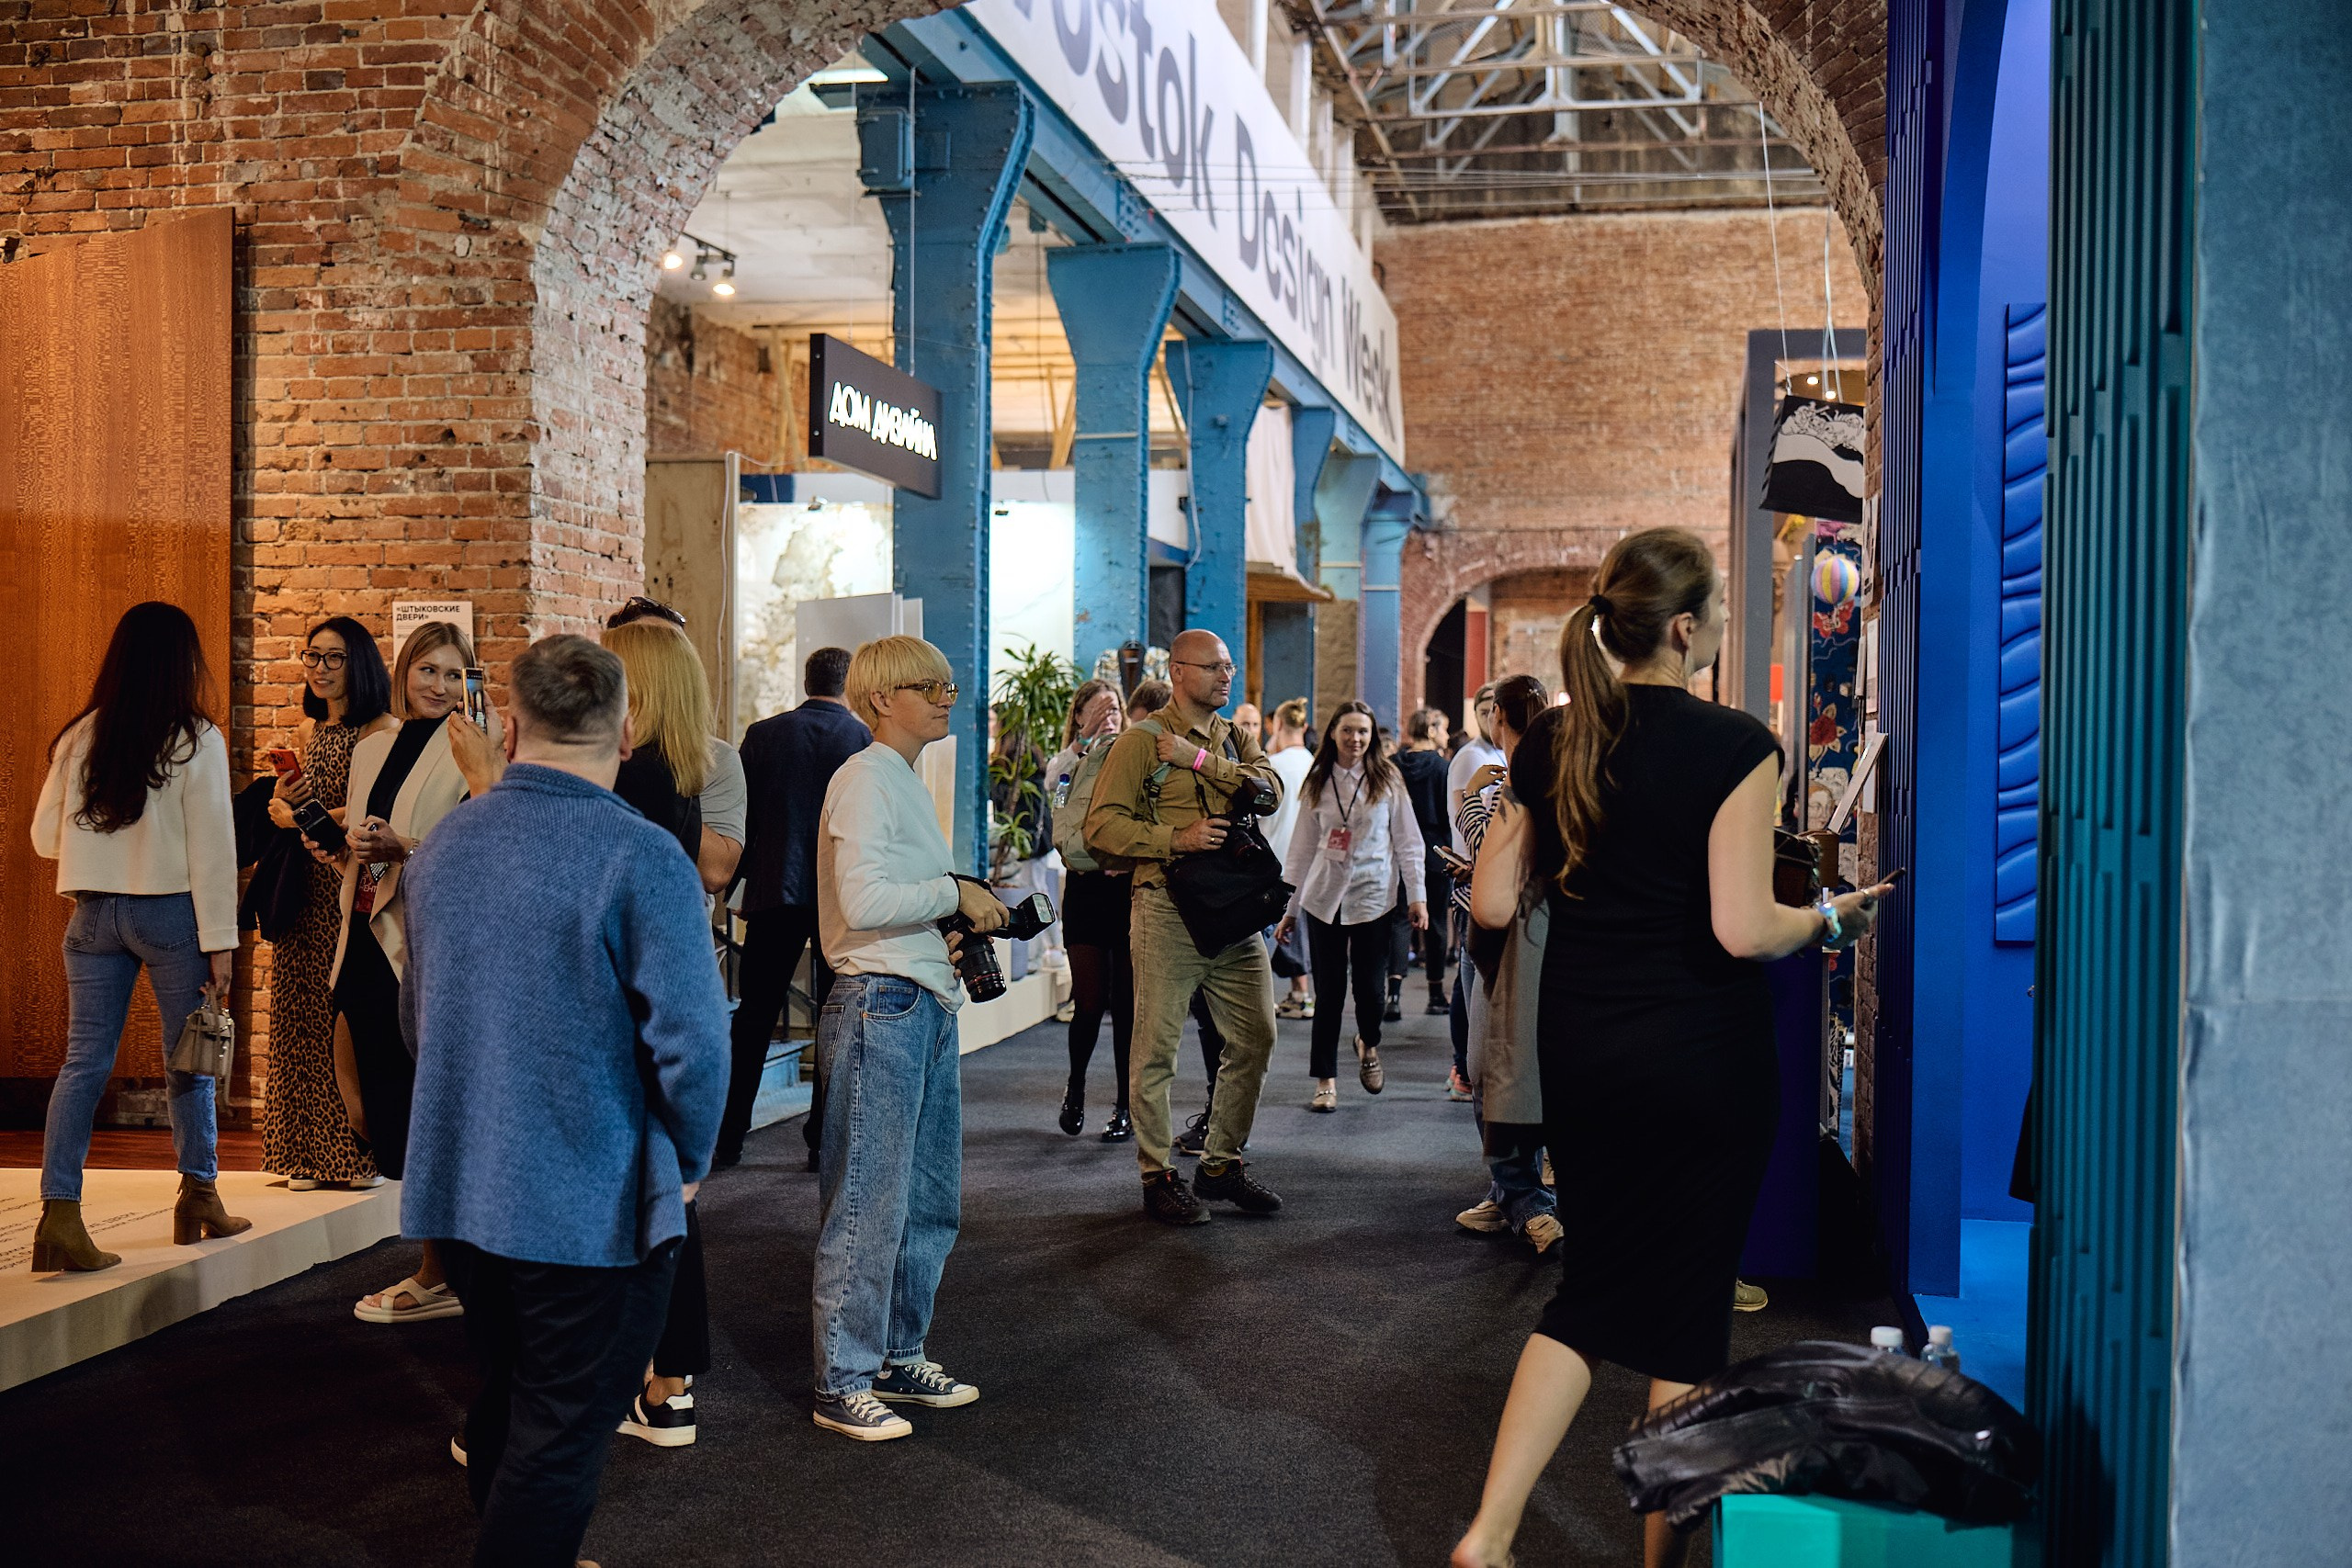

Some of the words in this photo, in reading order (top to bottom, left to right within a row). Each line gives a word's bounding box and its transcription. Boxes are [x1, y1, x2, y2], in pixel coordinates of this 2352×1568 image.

[1013, 0, 1217, 231] stok
[1236, 112, 1334, 379] Design
[829, 381, 871, 433] ДОМ
